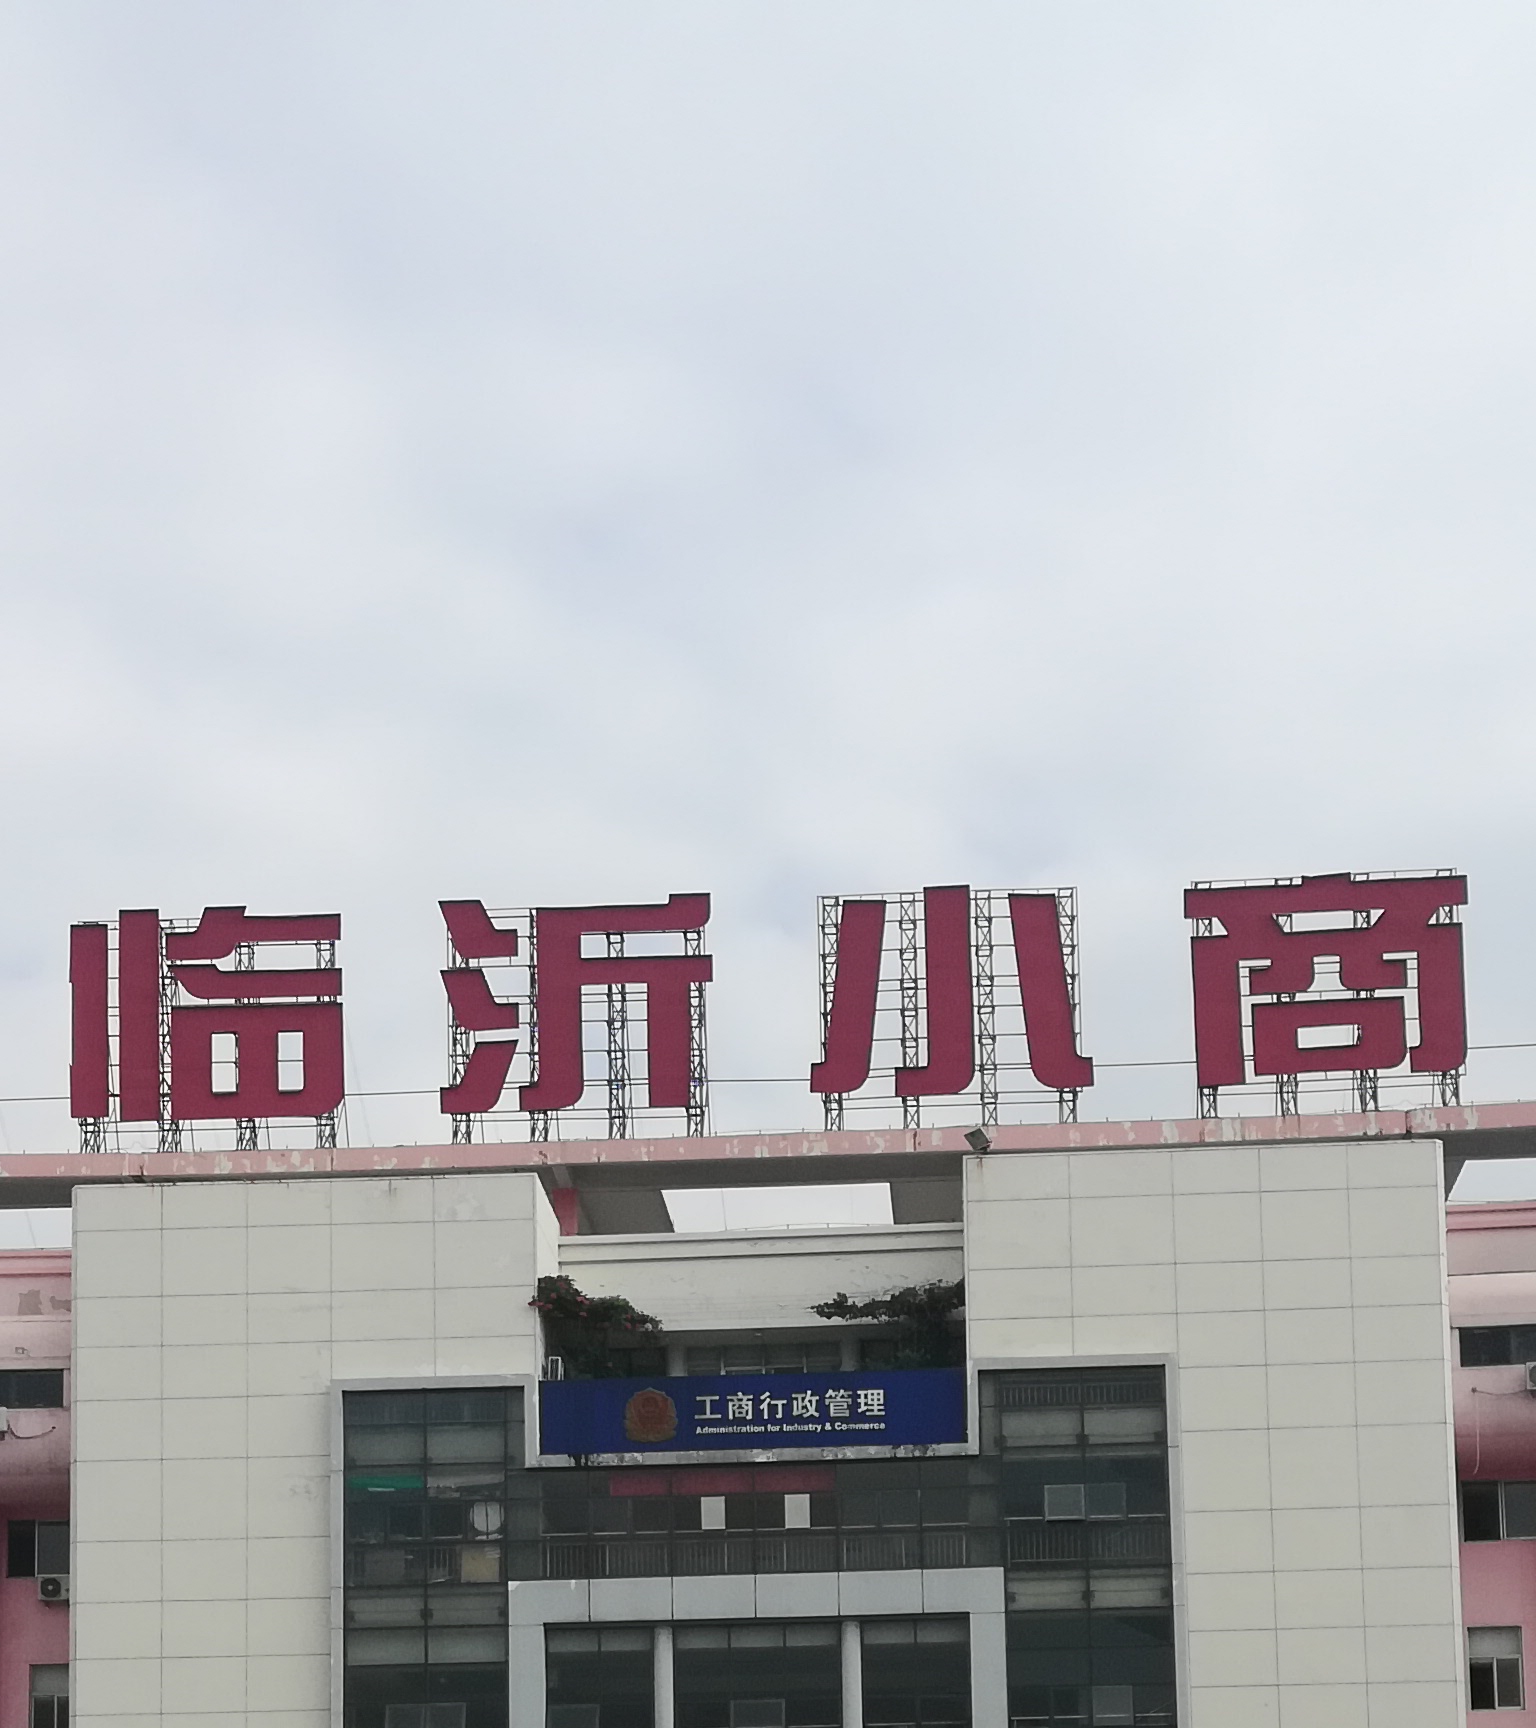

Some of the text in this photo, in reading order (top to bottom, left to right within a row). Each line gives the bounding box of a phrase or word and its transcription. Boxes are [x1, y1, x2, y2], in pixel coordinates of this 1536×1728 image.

[694, 1389, 886, 1420] 工商行政管理
[696, 1422, 886, 1435] Administration for Industry & Commerce
